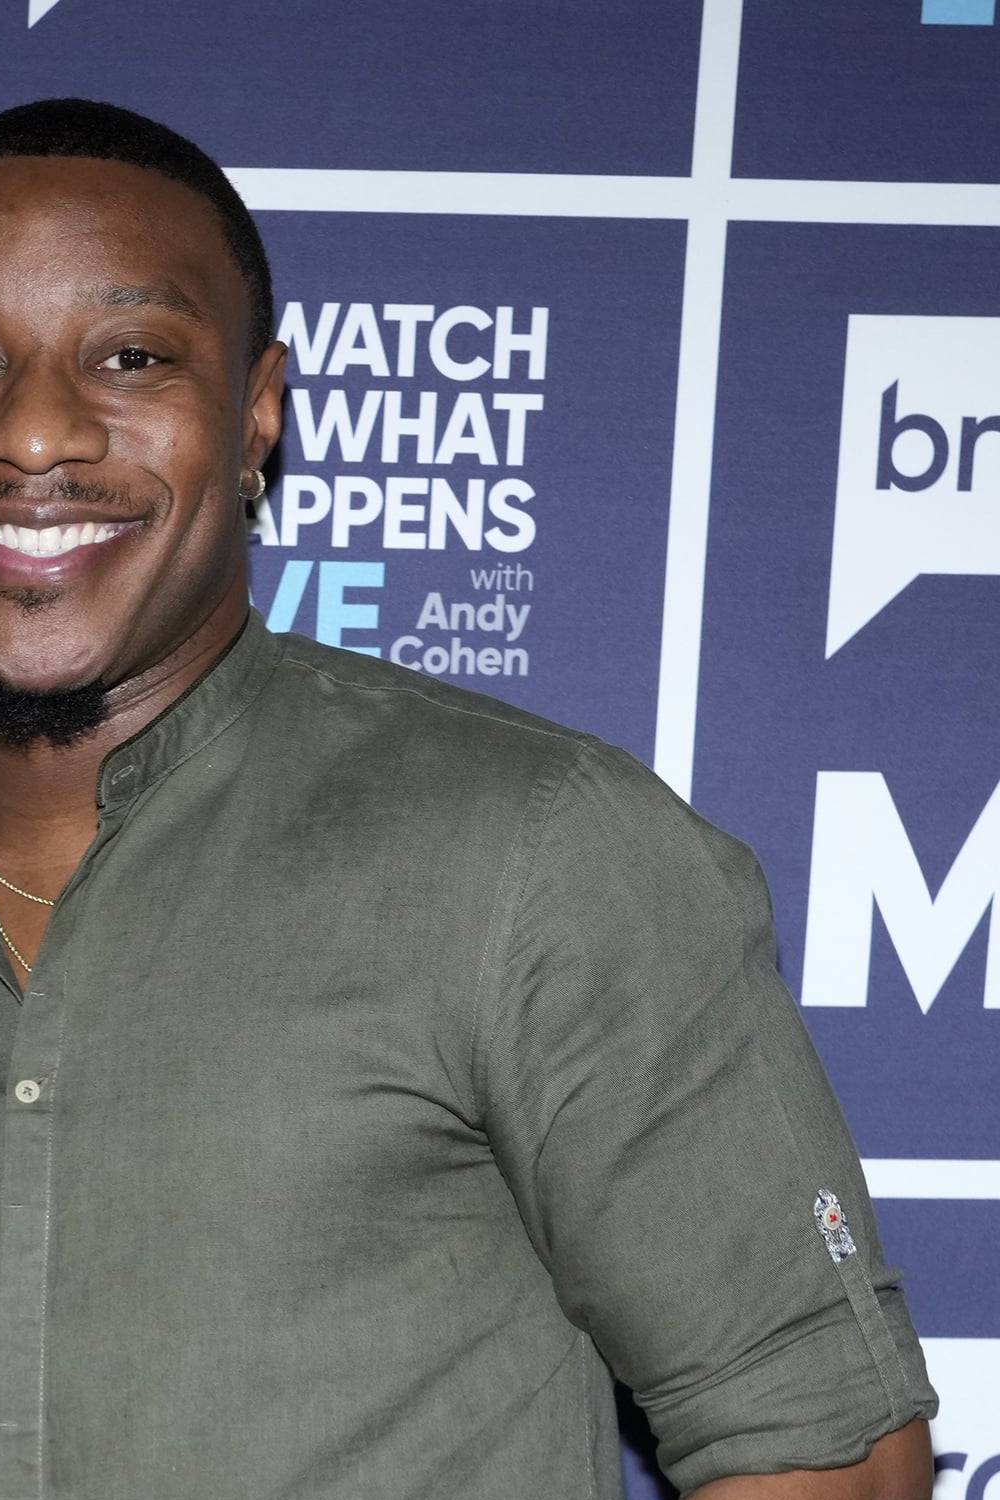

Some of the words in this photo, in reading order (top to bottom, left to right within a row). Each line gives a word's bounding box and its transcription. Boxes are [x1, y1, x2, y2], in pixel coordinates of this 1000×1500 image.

[276, 301, 549, 381] WATCH
[291, 388, 544, 466] WHAT
[470, 563, 534, 591] with
[416, 592, 531, 641] Andy
[389, 635, 529, 677] Cohen
